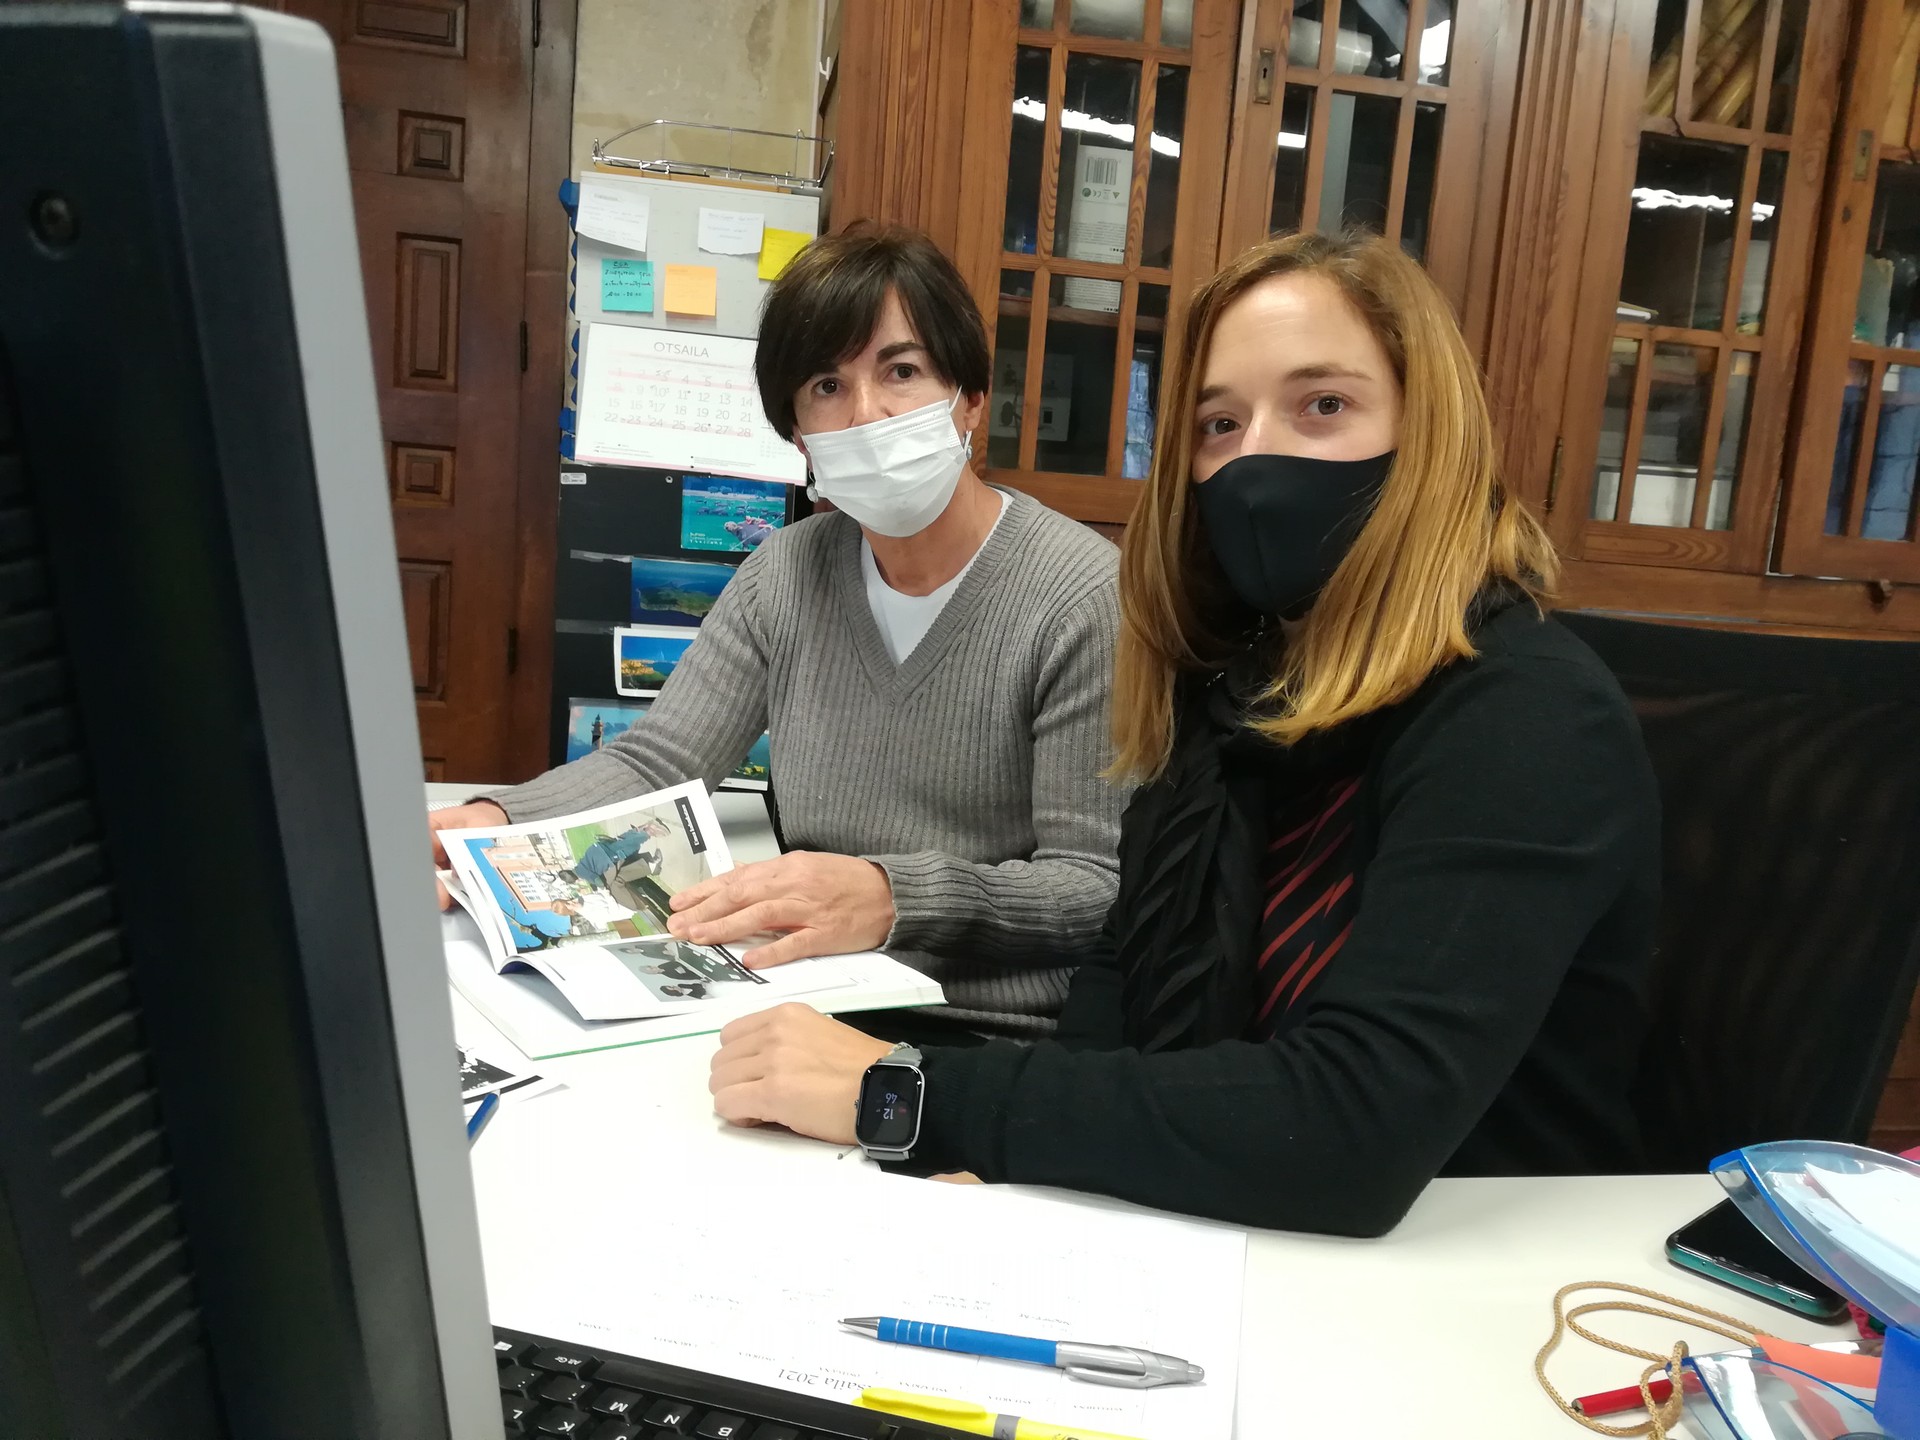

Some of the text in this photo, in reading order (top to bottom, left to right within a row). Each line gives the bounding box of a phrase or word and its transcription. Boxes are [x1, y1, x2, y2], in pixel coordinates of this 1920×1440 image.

[653, 341, 710, 359] OTSAILA
[681, 374, 689, 385] 4
[703, 375, 712, 387] 5
[724, 379, 733, 389] 6
[654, 386, 666, 398] 10
[677, 389, 688, 401] 11
[698, 391, 711, 402] 12
[719, 393, 731, 406] 13
[741, 396, 753, 408] 14
[608, 397, 752, 423] 15 16 17 18 19 20 21
[603, 411, 751, 438] 22 23 24 25 26 27 28
[885, 1092, 898, 1104] 46
[883, 1108, 894, 1120] 12
[777, 1367, 872, 1391] saila 2021
[610, 1400, 628, 1413] M
[512, 1409, 523, 1420] L
[663, 1413, 680, 1425] N
[557, 1420, 575, 1432] K
[718, 1426, 733, 1437] B
